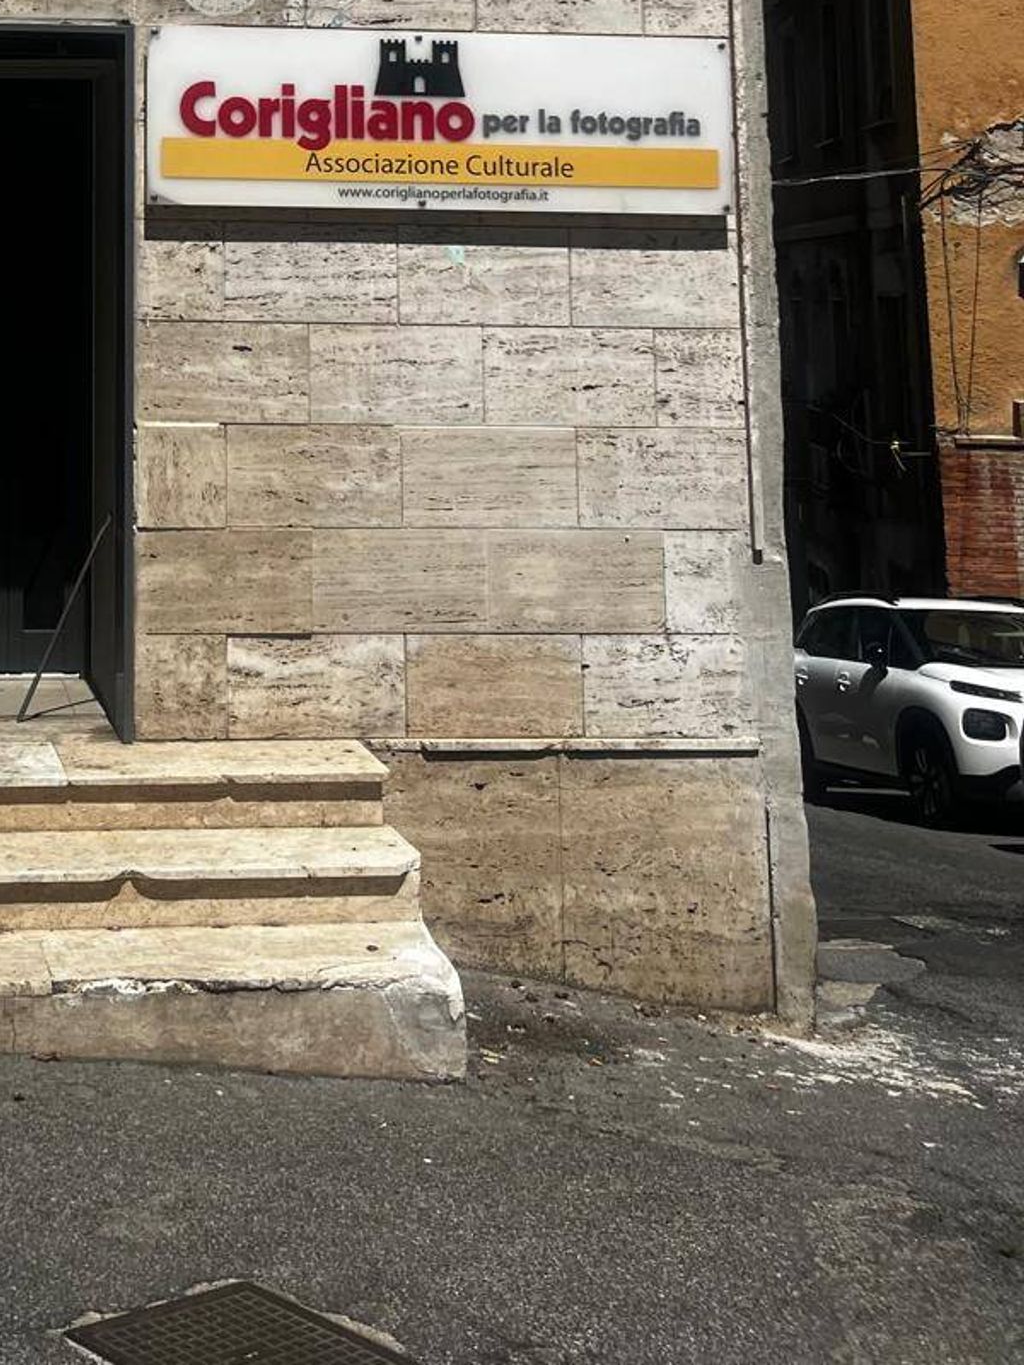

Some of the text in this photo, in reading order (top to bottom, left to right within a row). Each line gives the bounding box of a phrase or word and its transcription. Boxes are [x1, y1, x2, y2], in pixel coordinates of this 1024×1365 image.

[179, 81, 701, 150] Corigliano per la fotografia
[305, 153, 574, 178] Associazione Culturale
[338, 187, 550, 203] www.coriglianoperlafotografia.it
